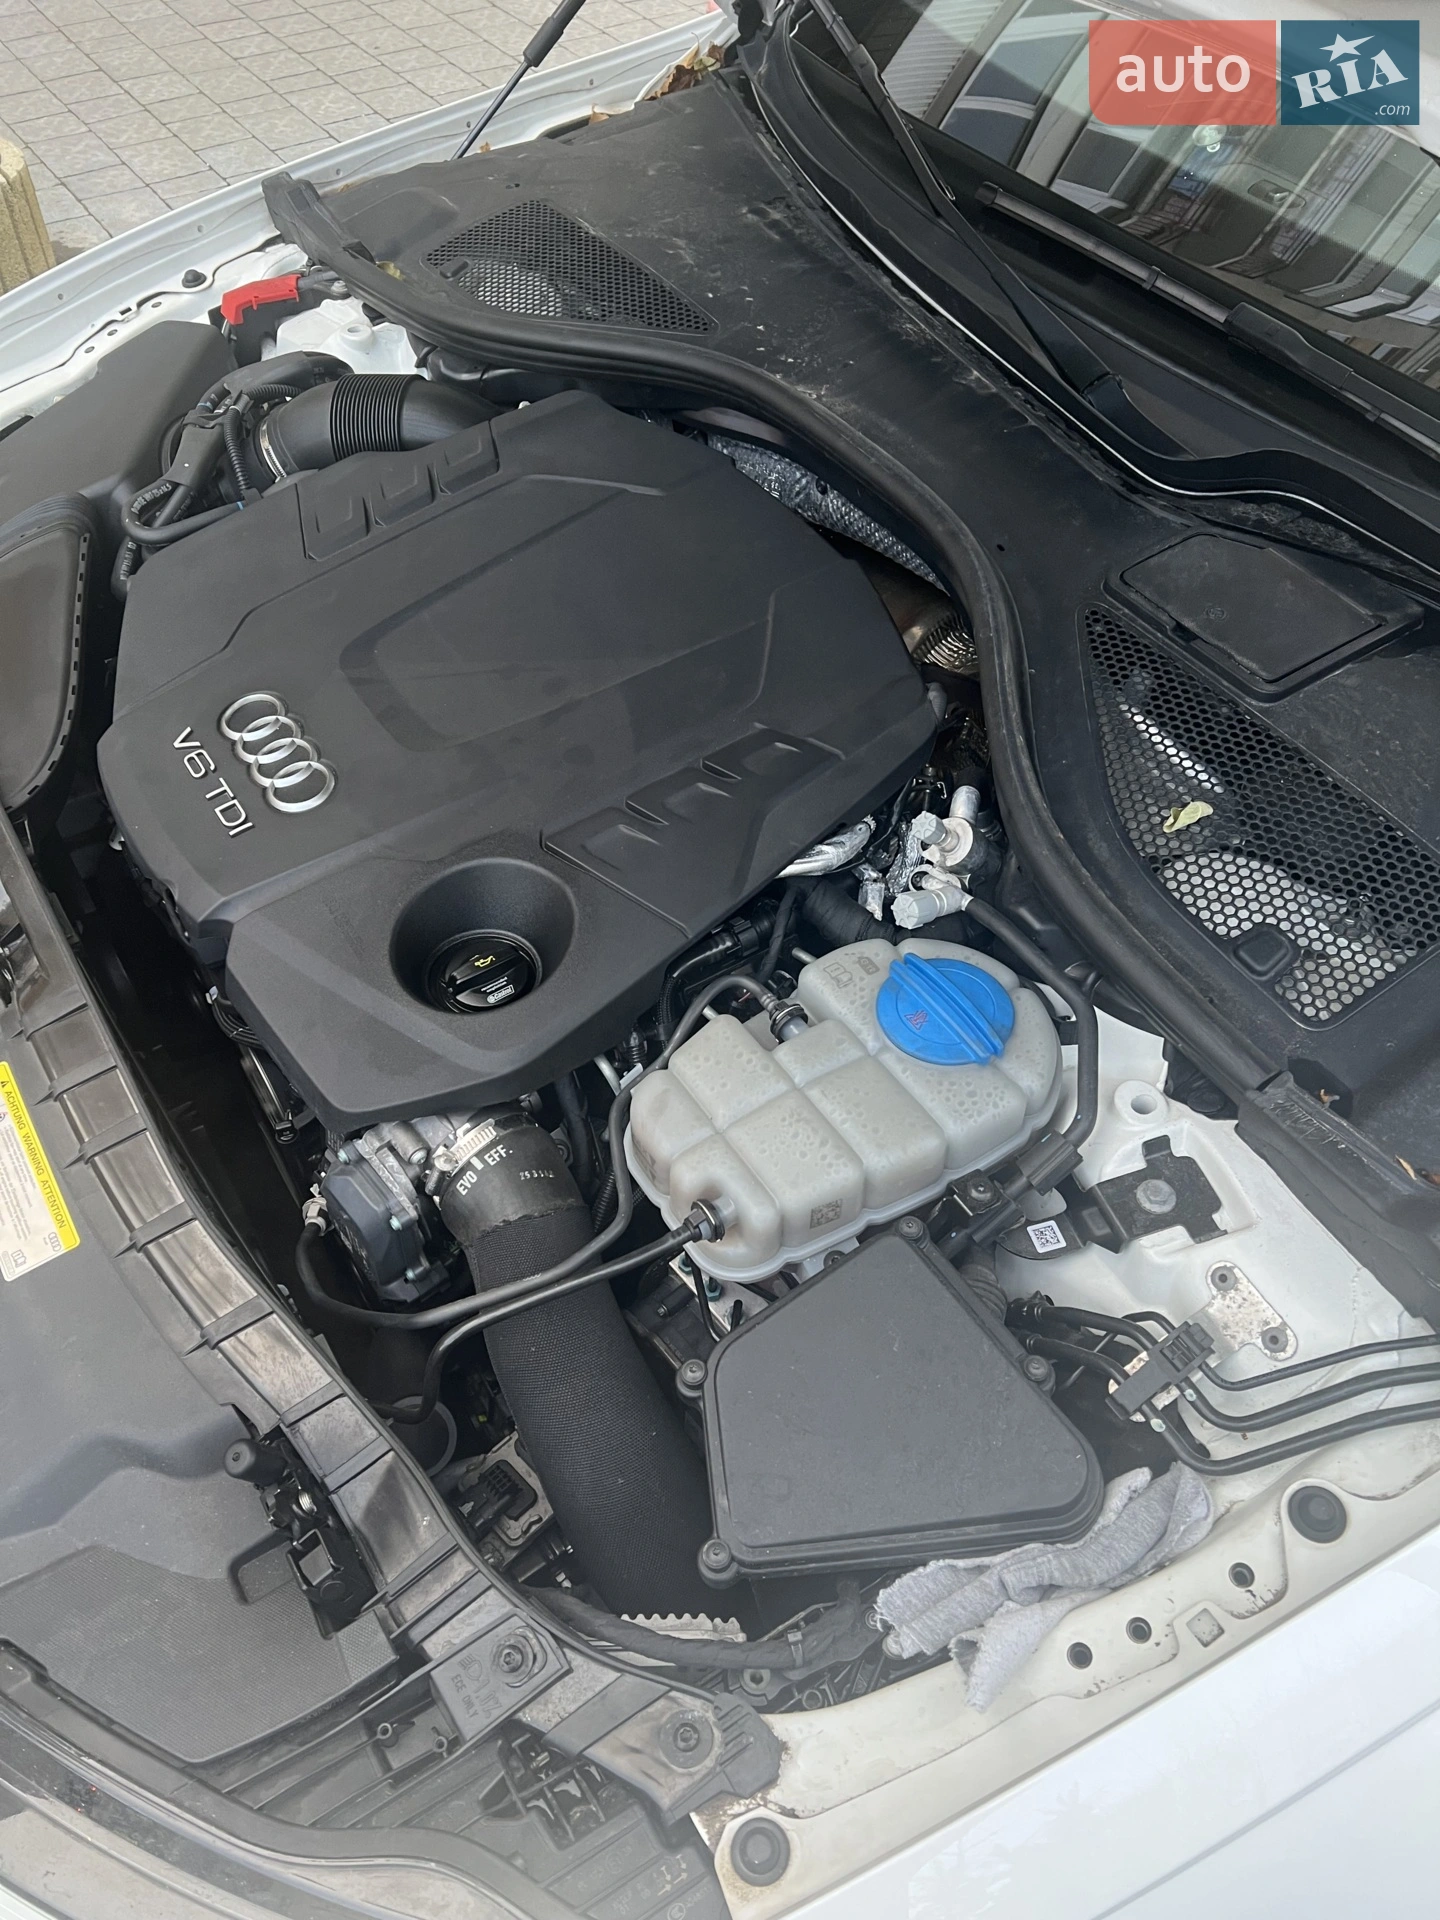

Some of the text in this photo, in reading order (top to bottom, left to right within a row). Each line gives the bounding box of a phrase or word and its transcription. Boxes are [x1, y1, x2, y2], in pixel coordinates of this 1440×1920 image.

[173, 726, 253, 836] V6 TDI
[5, 1091, 26, 1131] ACHTUNG
[22, 1132, 45, 1176] WARNING
[40, 1179, 67, 1229] ATTENTION
[456, 1144, 513, 1195] EVO EFF.
[452, 1673, 479, 1718] ECE ONLY
